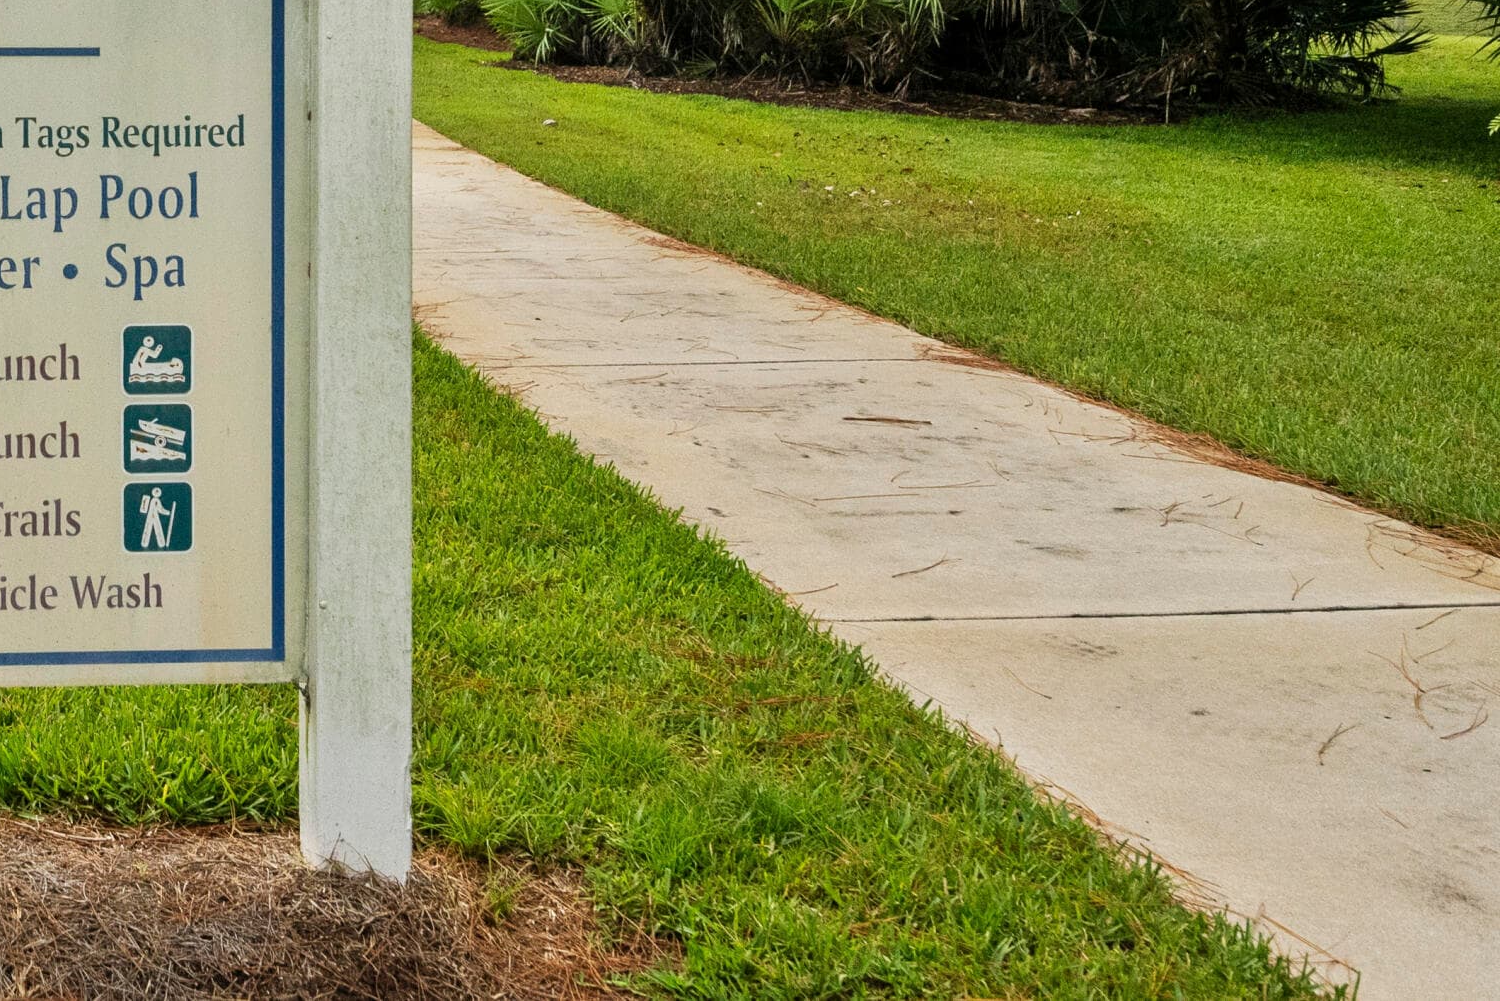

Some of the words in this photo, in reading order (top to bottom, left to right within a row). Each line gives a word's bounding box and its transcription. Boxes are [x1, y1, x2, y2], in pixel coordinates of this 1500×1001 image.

[14, 116, 90, 158] Tags
[101, 113, 245, 158] Required
[0, 175, 79, 233] Lap
[99, 170, 200, 220] Pool
[104, 242, 186, 302] Spa
[69, 571, 164, 610] Wash
